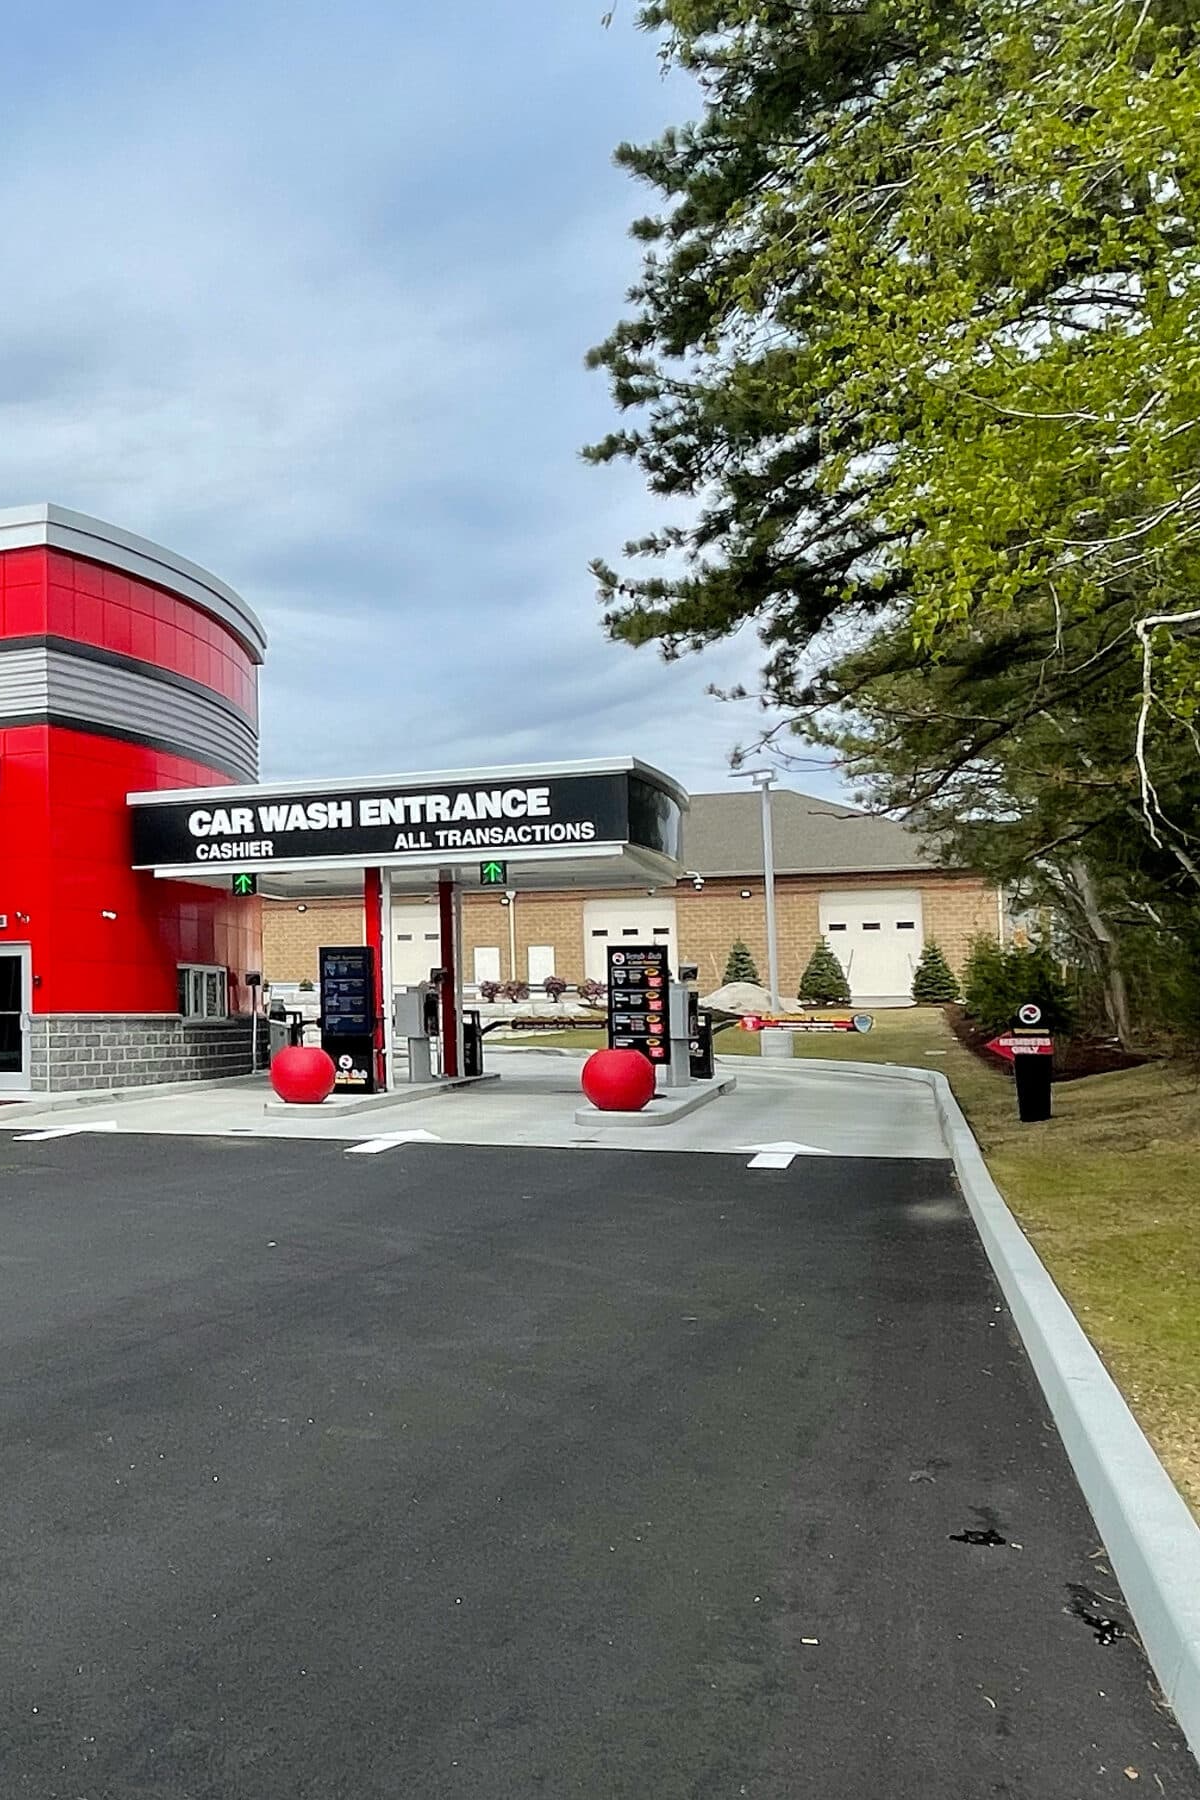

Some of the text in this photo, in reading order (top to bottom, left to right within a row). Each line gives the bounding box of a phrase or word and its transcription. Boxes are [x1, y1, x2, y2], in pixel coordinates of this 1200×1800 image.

[188, 787, 551, 837] CAR WASH ENTRANCE
[196, 821, 596, 860] CASHIER ALL TRANSACTIONS
